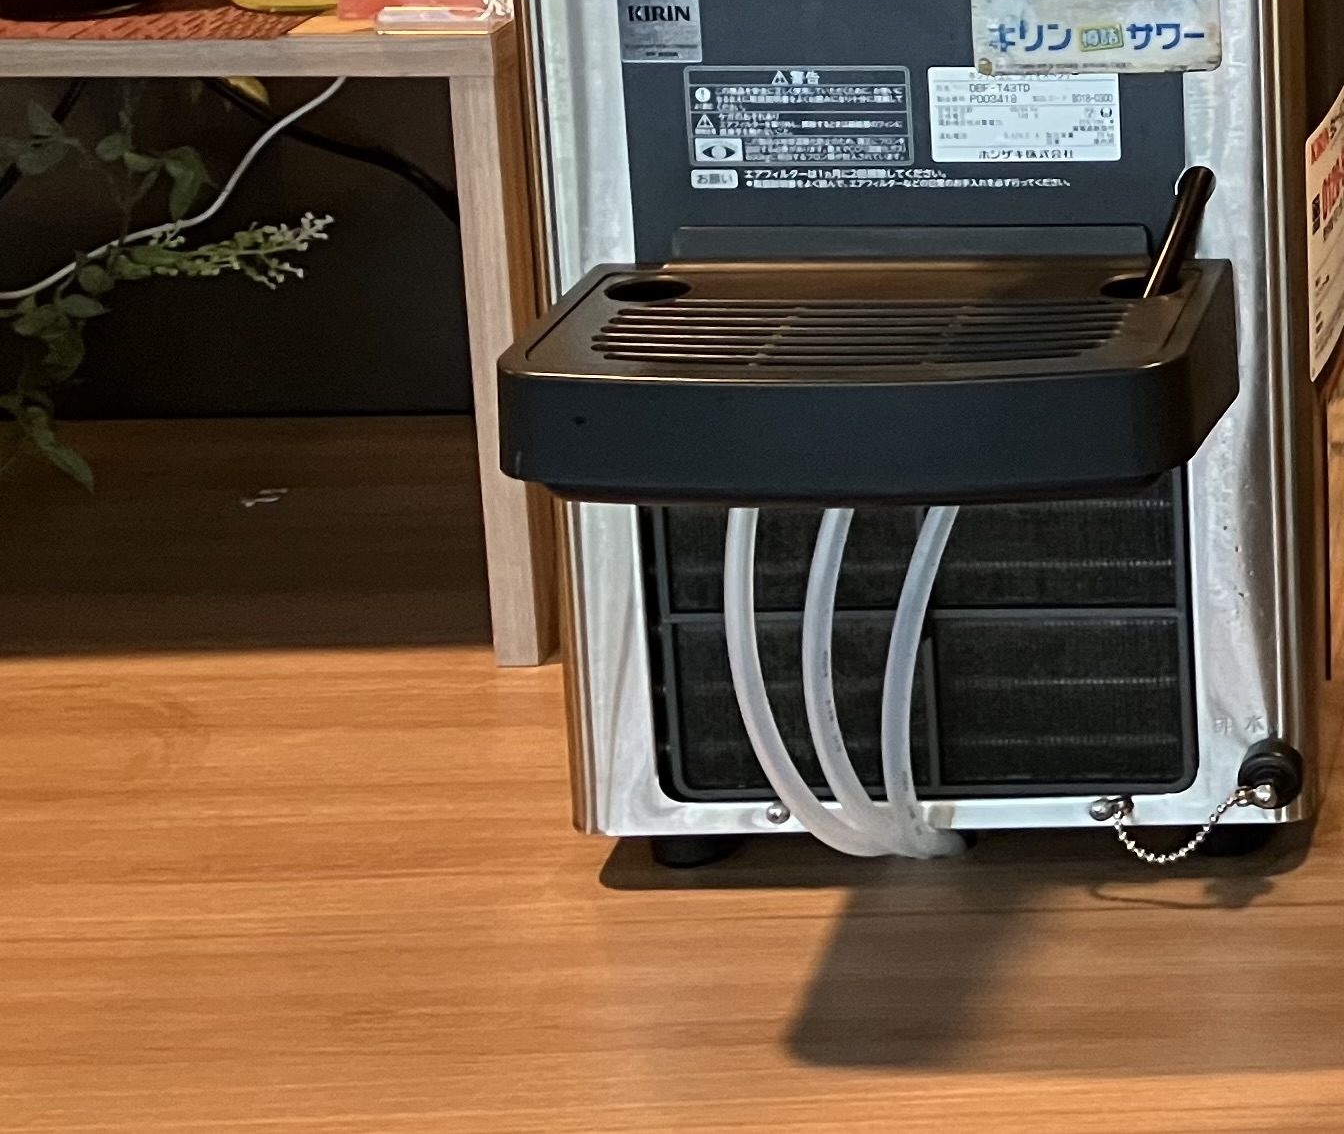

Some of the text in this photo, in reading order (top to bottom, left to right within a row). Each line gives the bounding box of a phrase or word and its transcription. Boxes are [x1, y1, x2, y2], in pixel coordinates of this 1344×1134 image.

[628, 5, 691, 22] KIRIN
[696, 174, 734, 185] お願い
